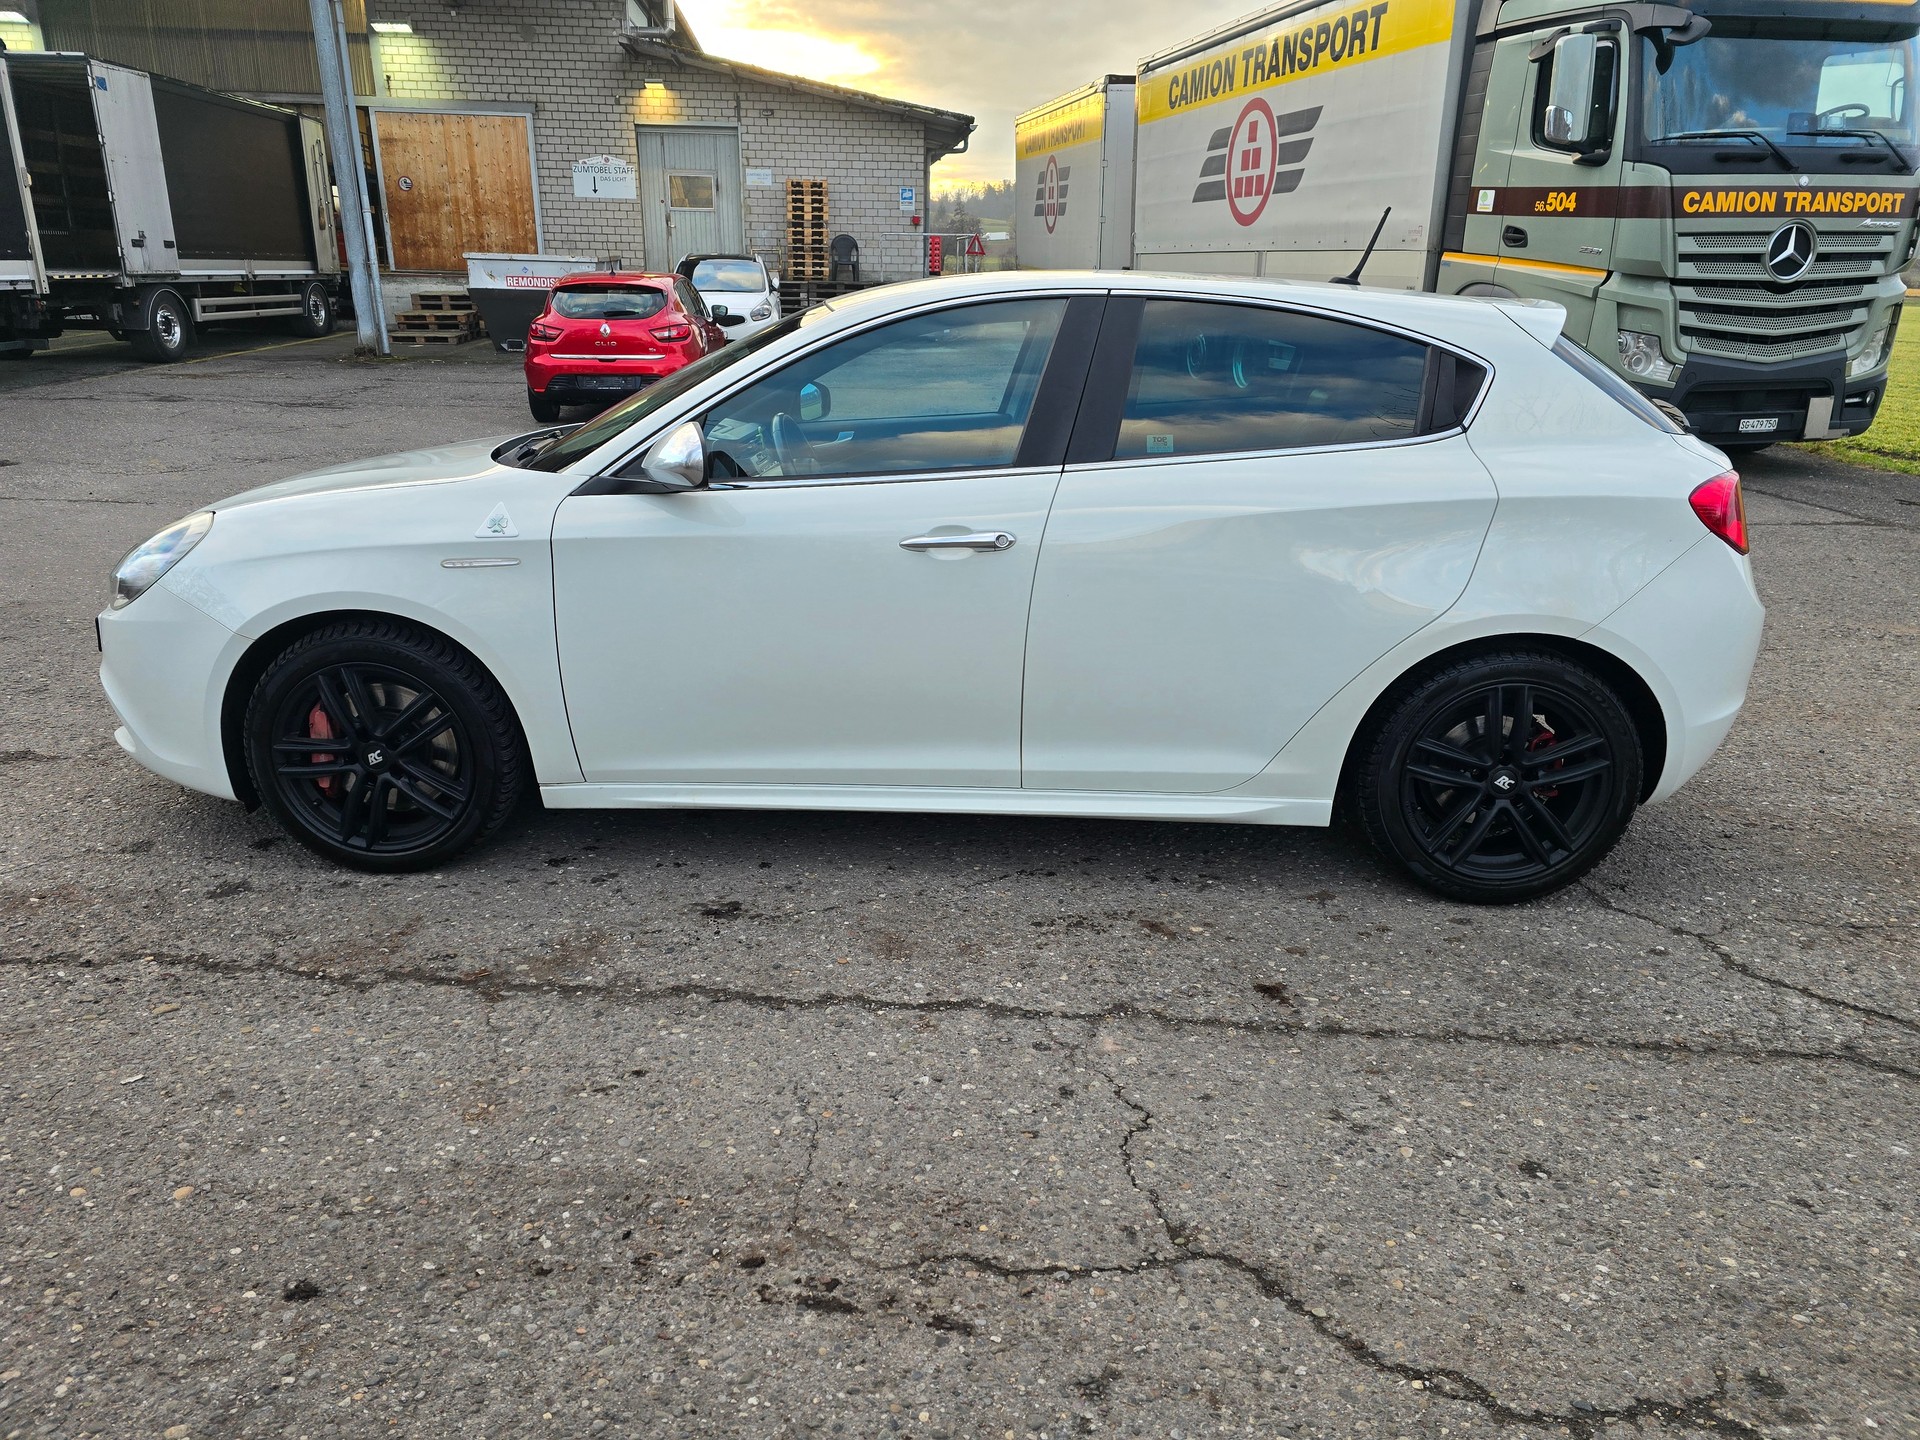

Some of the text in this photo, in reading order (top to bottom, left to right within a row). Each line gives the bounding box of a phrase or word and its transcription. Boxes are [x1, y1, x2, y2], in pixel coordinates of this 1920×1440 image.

[1168, 2, 1389, 110] CAMION TRANSPORT
[573, 165, 634, 175] ZUMTOBEL STAFF
[1683, 191, 1905, 213] CAMION TRANSPORT
[367, 749, 383, 766] RC
